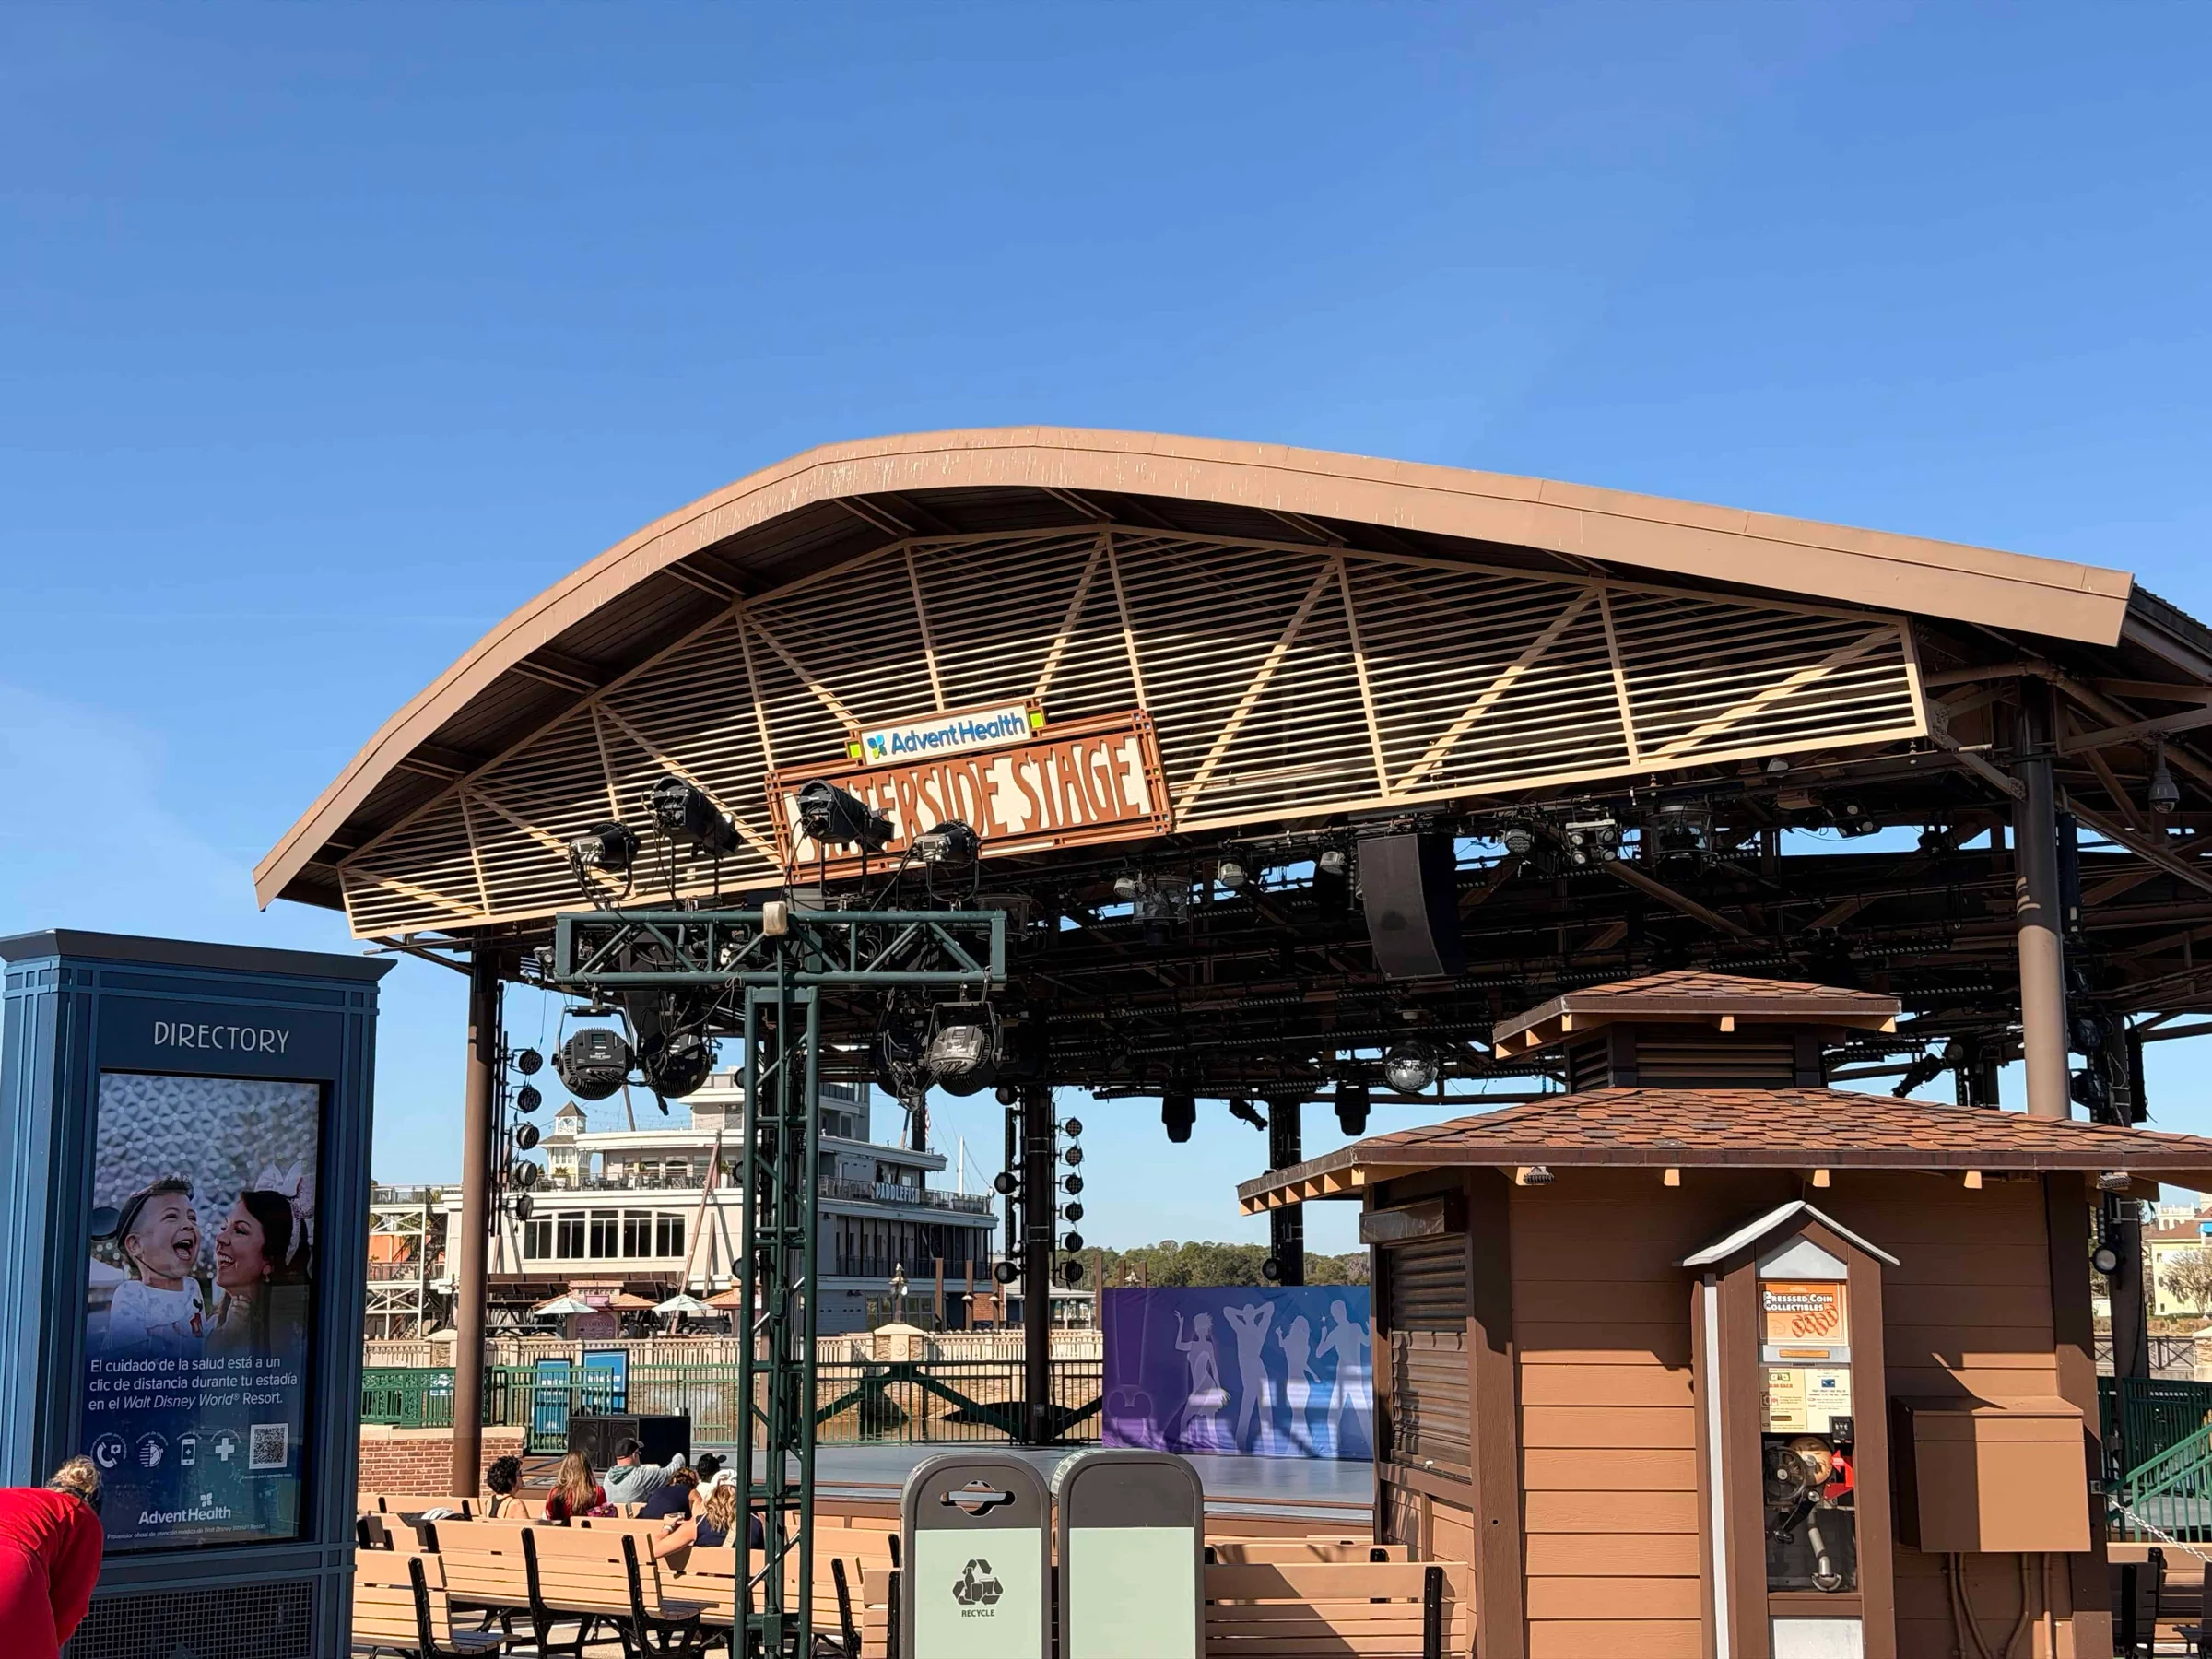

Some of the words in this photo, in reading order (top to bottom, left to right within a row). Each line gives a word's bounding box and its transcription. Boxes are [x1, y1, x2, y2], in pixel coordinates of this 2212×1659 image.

[890, 712, 1027, 755] AdventHealth
[1011, 735, 1142, 831] STAGE
[154, 1021, 289, 1053] DIRECTORY
[1763, 1300, 1824, 1312] COLLECTIBLES
[1809, 1293, 1833, 1303] COIN
[90, 1359, 102, 1372] El
[105, 1359, 156, 1372] cuidado
[159, 1358, 175, 1371] de
[178, 1357, 189, 1371] la
[192, 1356, 225, 1370] salud
[227, 1355, 253, 1369] está
[255, 1358, 263, 1368] a
[265, 1357, 281, 1368] un
[89, 1378, 111, 1392] clic
[113, 1377, 130, 1391] de
[133, 1376, 188, 1390] distancia
[191, 1375, 238, 1388] durante
[241, 1374, 253, 1387] tu
[255, 1371, 298, 1386] estadía
[88, 1399, 105, 1411] en
[108, 1396, 120, 1410] el
[124, 1395, 151, 1409] Walt
[153, 1394, 196, 1410] Disney
[242, 1392, 284, 1406] Resort.
[138, 1506, 231, 1524] AdventHealth
[961, 1609, 995, 1618] RECYCLE
